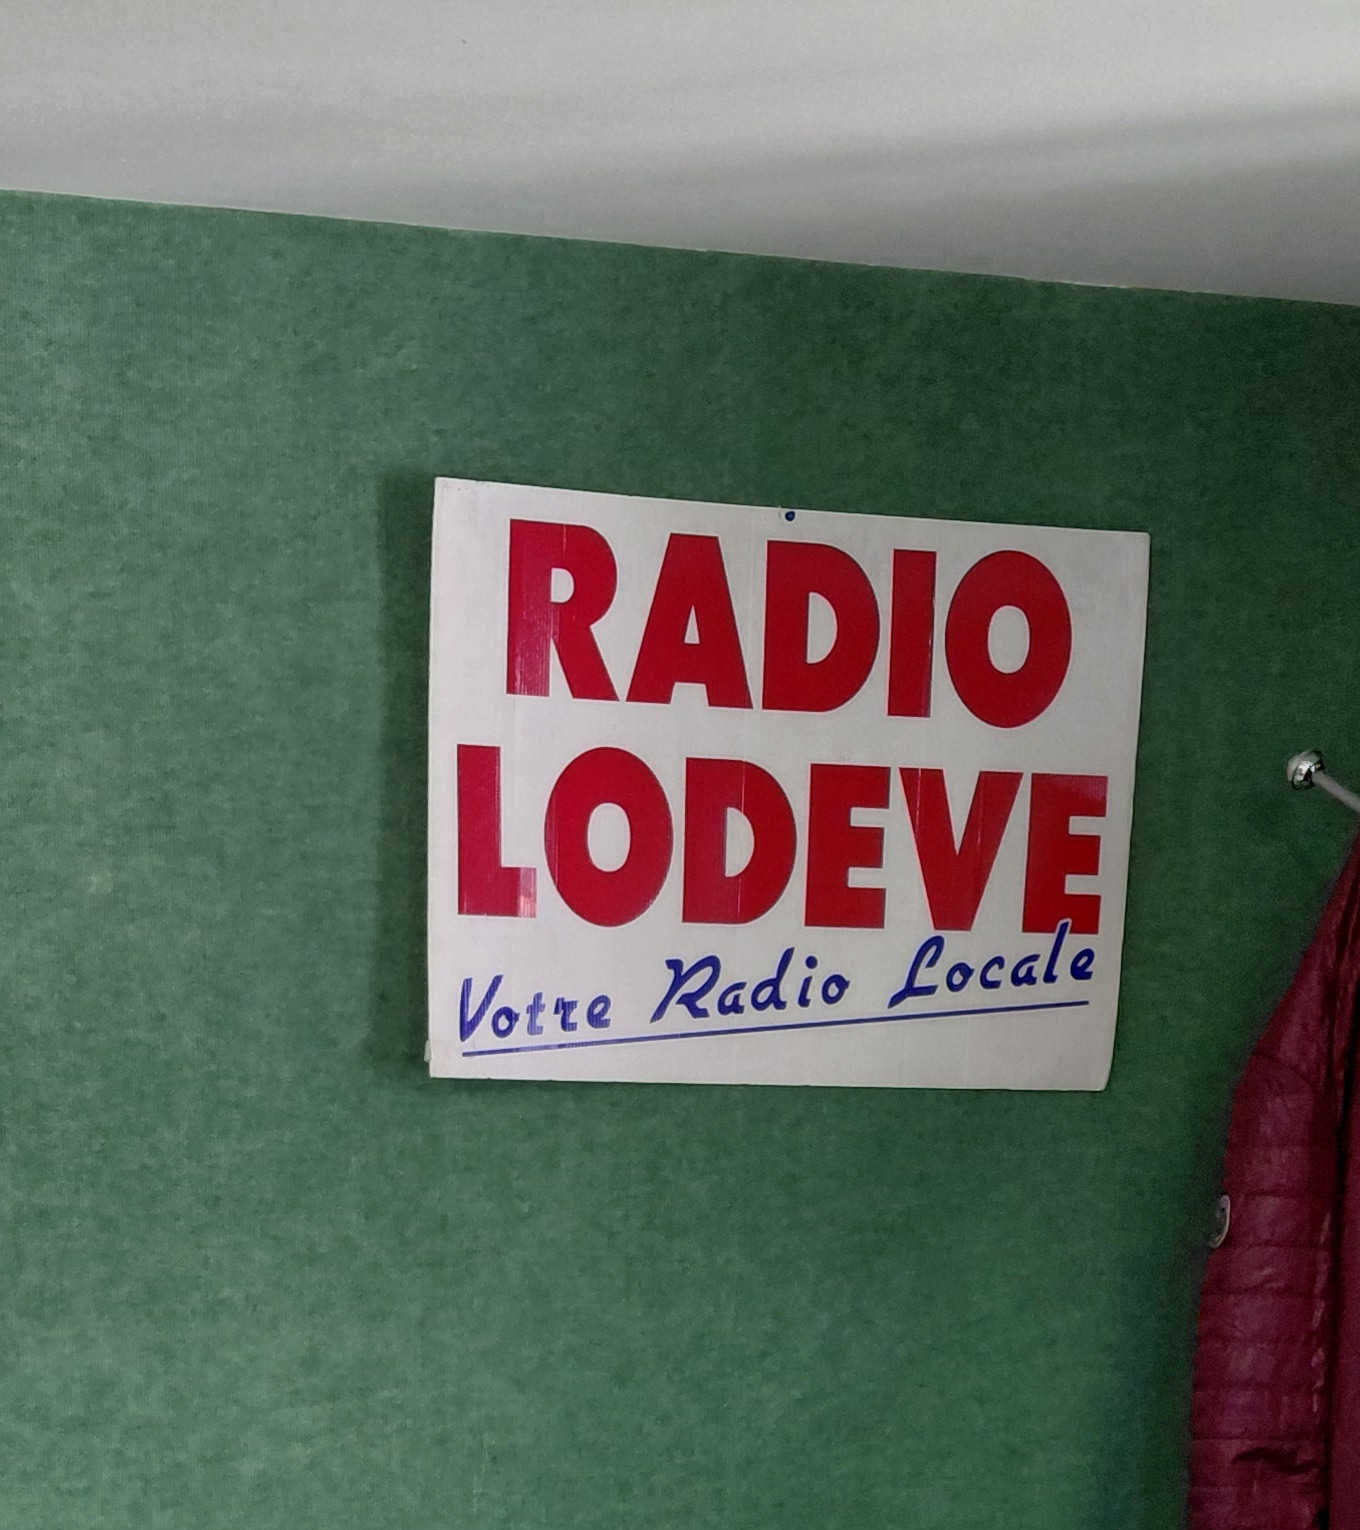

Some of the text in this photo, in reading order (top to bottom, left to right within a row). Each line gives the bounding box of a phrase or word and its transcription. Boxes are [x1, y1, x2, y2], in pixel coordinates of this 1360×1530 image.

[506, 518, 1072, 728] RADIO
[457, 743, 1109, 935] LODEVE
[458, 918, 1095, 1043] Votre Radio Locale
